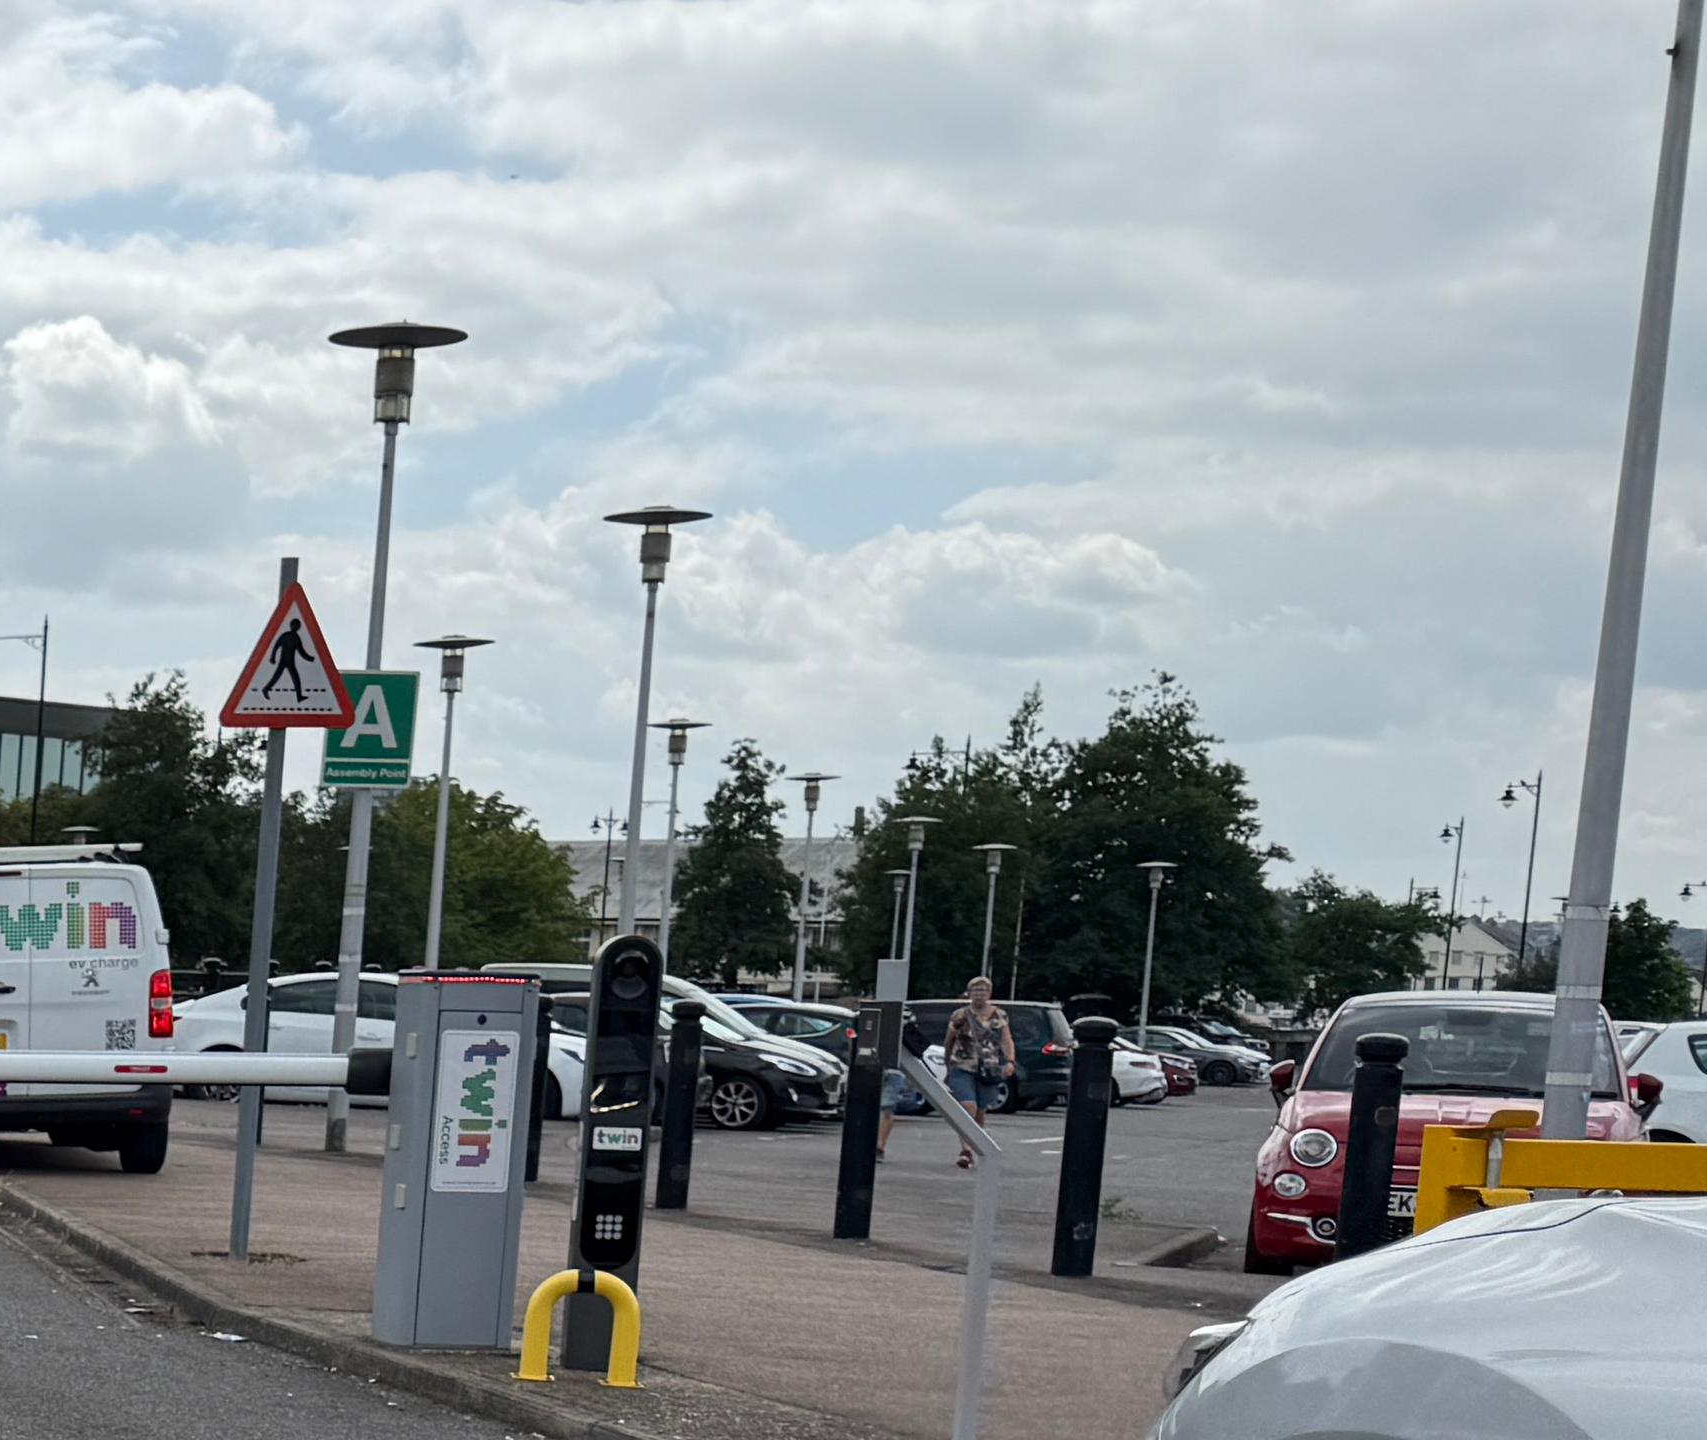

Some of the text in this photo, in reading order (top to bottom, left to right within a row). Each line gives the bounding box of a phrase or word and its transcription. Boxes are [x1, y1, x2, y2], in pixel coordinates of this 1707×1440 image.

[339, 684, 398, 749] A
[327, 767, 407, 779] Assembly Point
[68, 957, 139, 970] ev charge
[455, 1038, 511, 1168] twin
[439, 1115, 454, 1165] Access
[597, 1128, 639, 1145] twin
